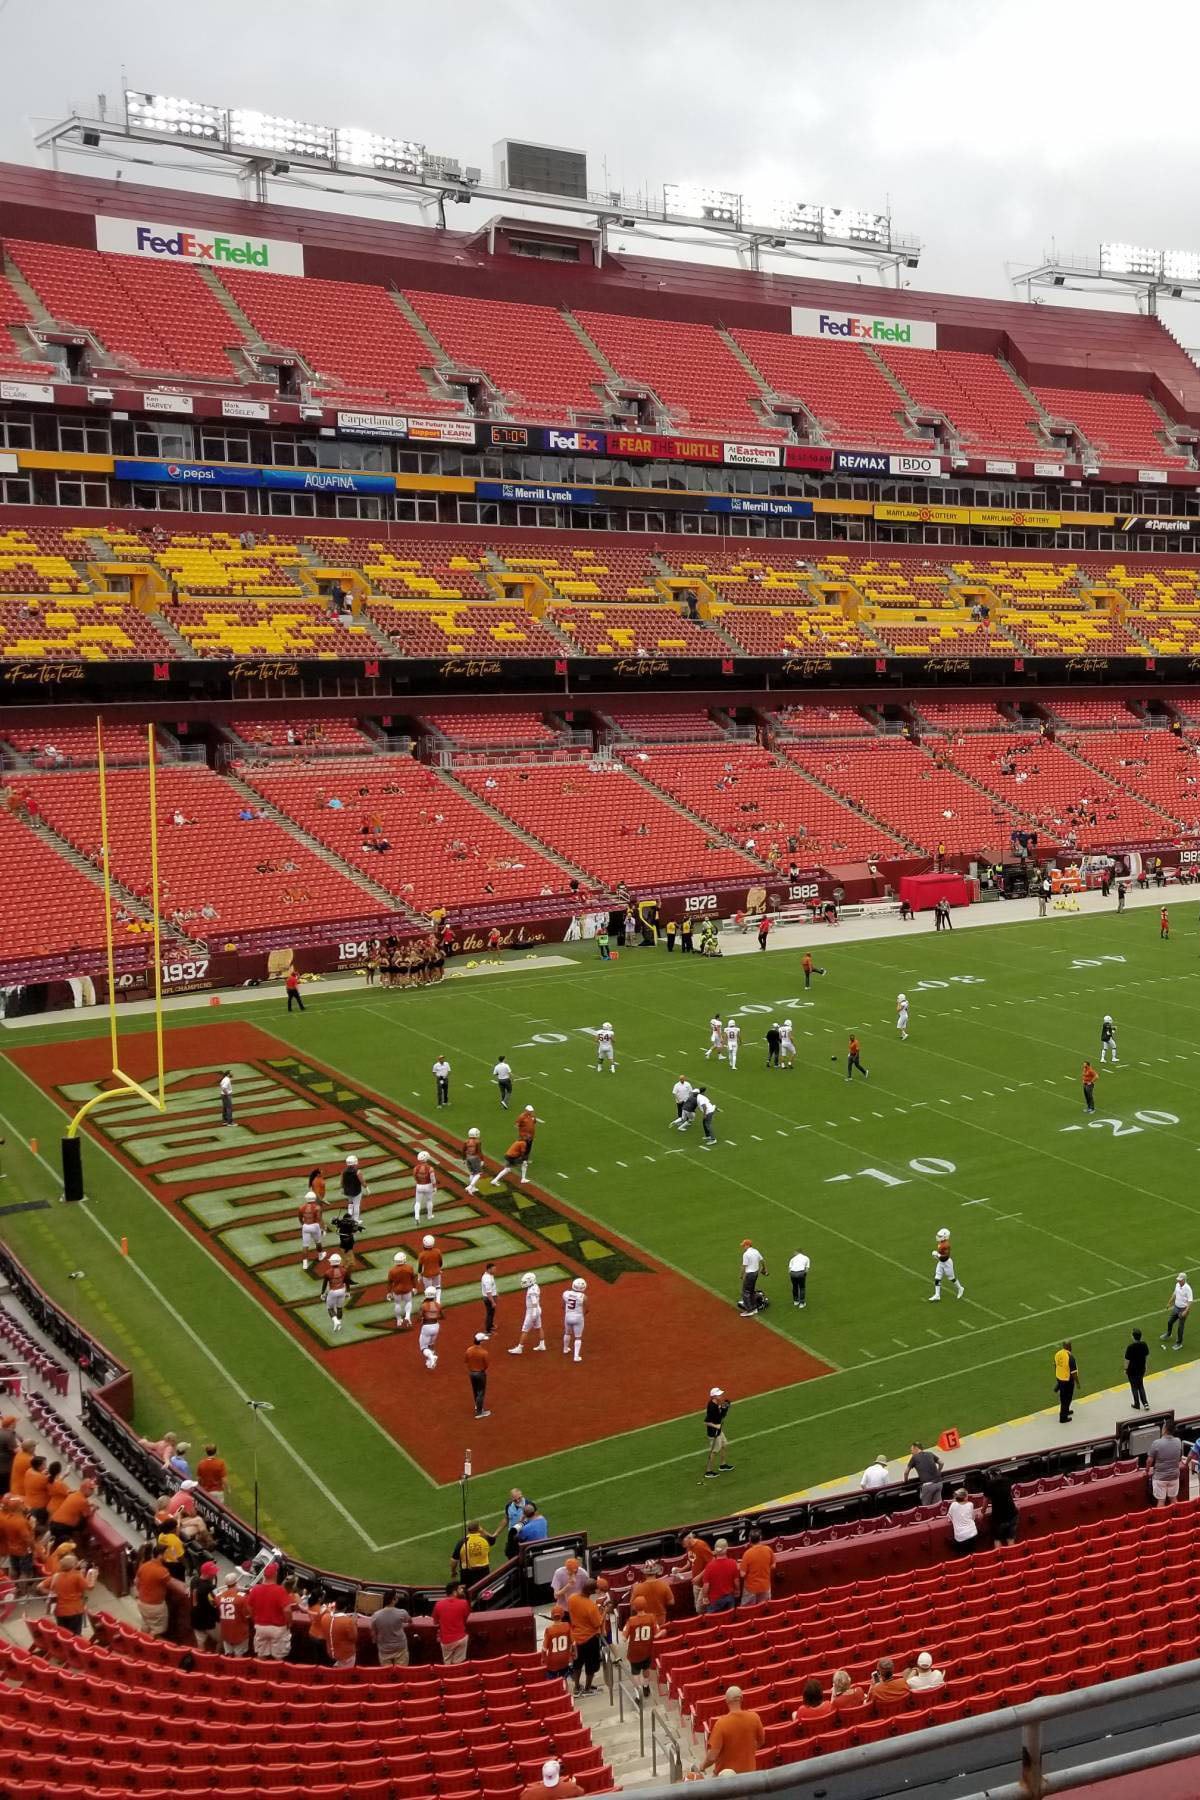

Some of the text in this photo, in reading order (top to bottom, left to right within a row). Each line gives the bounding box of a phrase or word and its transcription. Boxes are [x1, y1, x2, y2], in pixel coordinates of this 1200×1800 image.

[137, 227, 269, 267] FedExField
[819, 314, 911, 343] FedExField
[224, 407, 257, 417] MOSELEY
[341, 413, 394, 428] Carpetland
[442, 429, 472, 437] LEARN
[549, 431, 599, 451] FedEx
[736, 446, 776, 457] Eastern
[839, 455, 886, 470] RE/MAX
[903, 459, 931, 471] BDO
[183, 468, 215, 480] pepsi
[304, 473, 354, 489] AQUAFINA
[515, 487, 572, 502] Merrill Lynch
[742, 500, 792, 514] Merrill Lynch
[886, 509, 957, 520] MARYLAND LOTTERY
[1024, 516, 1049, 524] LOTTERY
[788, 884, 819, 900] 1982
[685, 895, 717, 912] 1972
[463, 934, 484, 951] the
[161, 960, 209, 984] 1937
[161, 981, 213, 995] NFL CHAMPIONS
[1088, 1110, 1180, 1137] 20
[856, 1157, 957, 1188] 10
[567, 1299, 576, 1310] 3
[946, 1431, 957, 1448] G
[220, 1518, 240, 1543] SEATS
[220, 1603, 236, 1620] 12
[634, 1625, 651, 1642] 10
[551, 1635, 568, 1653] 10
